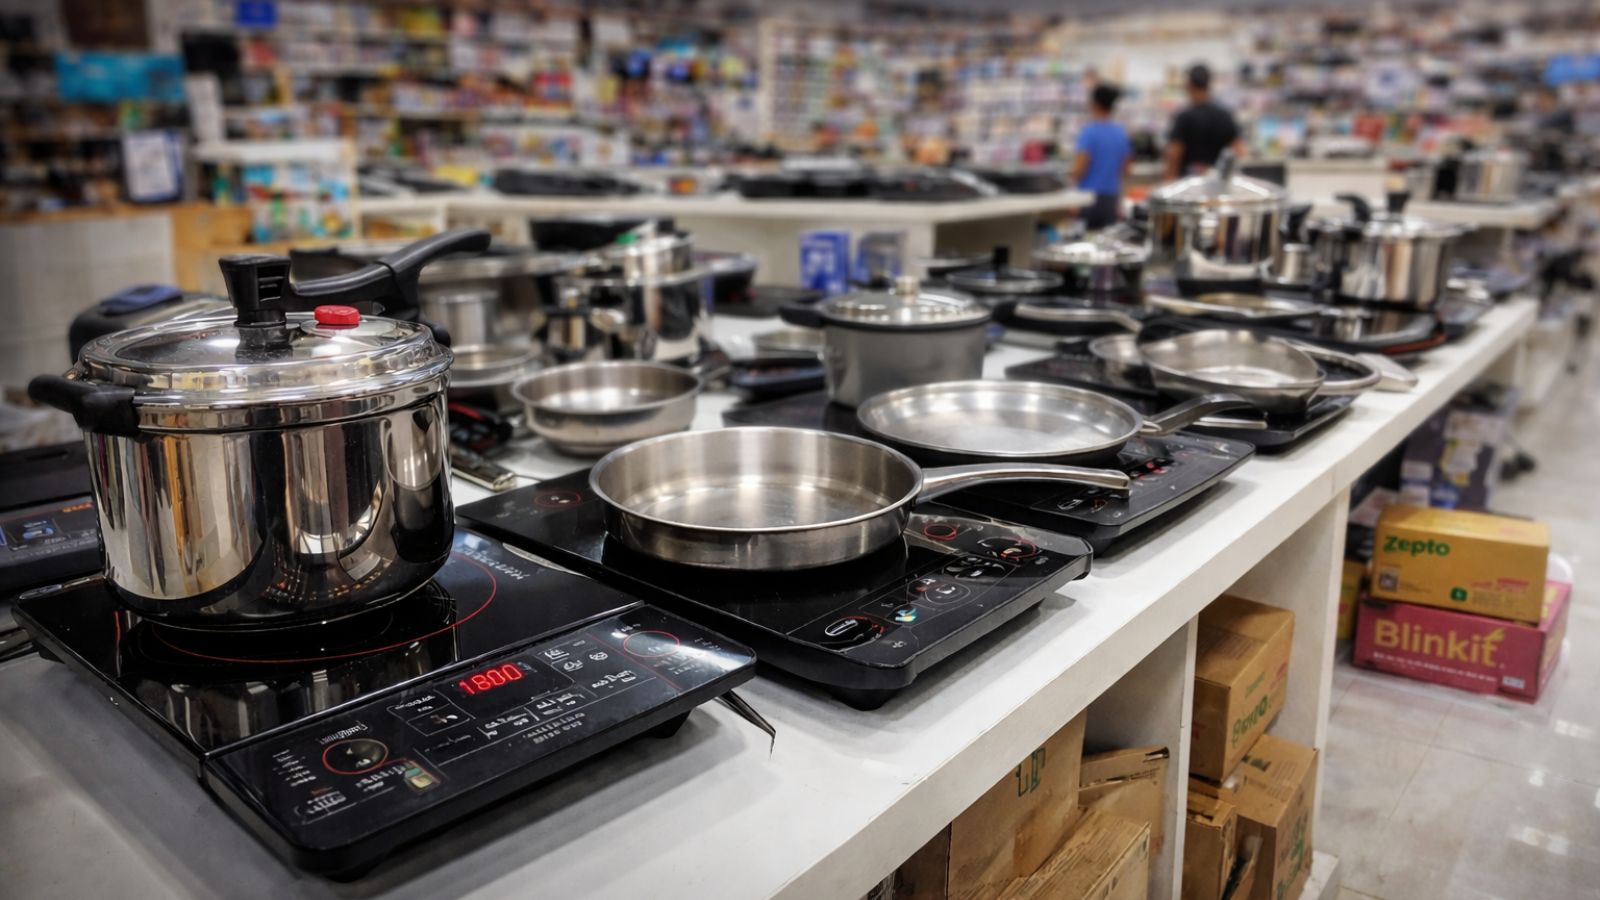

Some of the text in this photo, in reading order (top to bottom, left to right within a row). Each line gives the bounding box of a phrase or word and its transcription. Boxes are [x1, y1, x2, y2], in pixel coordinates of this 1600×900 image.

[1384, 535, 1450, 557] Zepto
[1375, 619, 1505, 668] Blinkit
[459, 664, 522, 695] 1800
